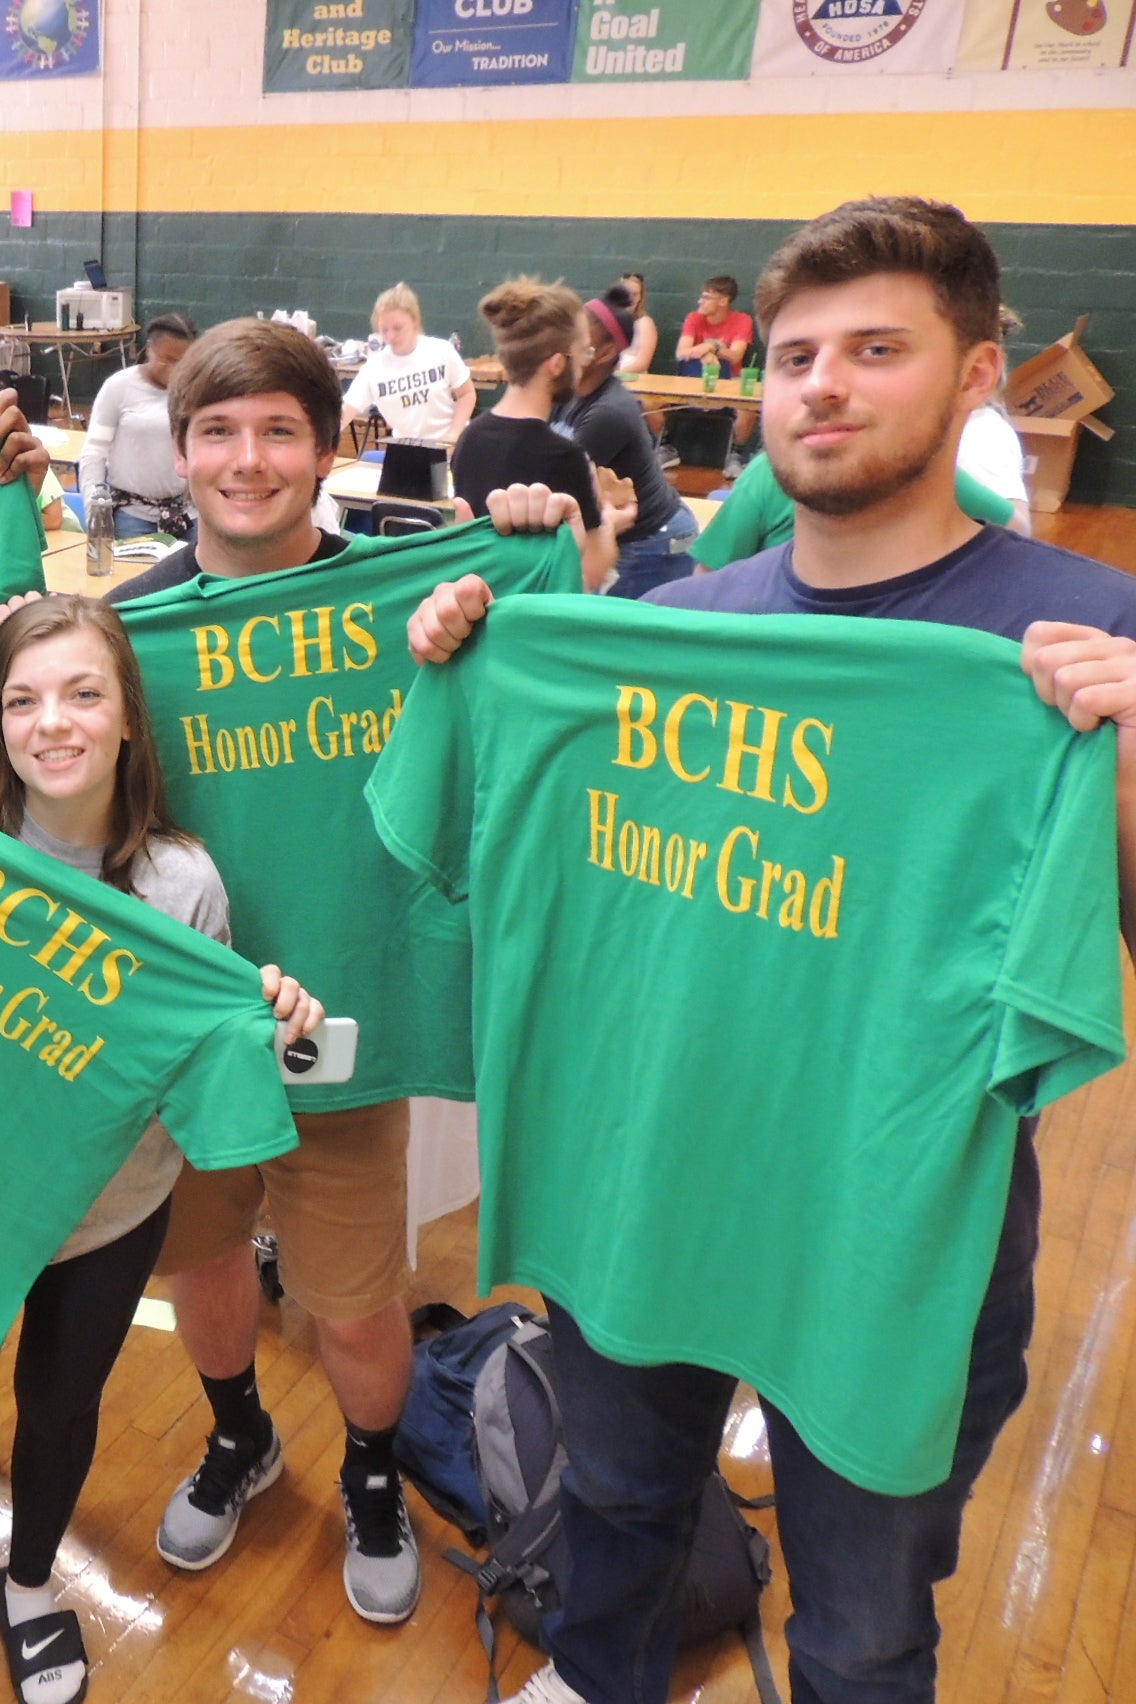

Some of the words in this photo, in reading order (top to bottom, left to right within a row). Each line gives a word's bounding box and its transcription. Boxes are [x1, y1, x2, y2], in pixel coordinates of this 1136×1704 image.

[314, 0, 363, 19] and
[454, 0, 533, 19] CLUB
[828, 0, 886, 17] HOSA
[590, 8, 660, 40] Goal
[822, 23, 862, 42] FOUNDED
[282, 26, 392, 50] Heritage
[432, 40, 452, 54] Our
[585, 42, 686, 75] United
[814, 42, 831, 55] OF
[834, 38, 892, 61] AMERICA
[306, 54, 363, 74] Club
[472, 54, 548, 71] TRADITION
[378, 365, 446, 397] DECISION
[401, 388, 430, 408] DAY
[190, 601, 378, 692] BCHS
[179, 714, 296, 775] Honor
[611, 684, 834, 815] BCHS
[586, 788, 708, 899] Honor
[717, 825, 847, 939] Grad
[37, 1669, 63, 1686] ABS
